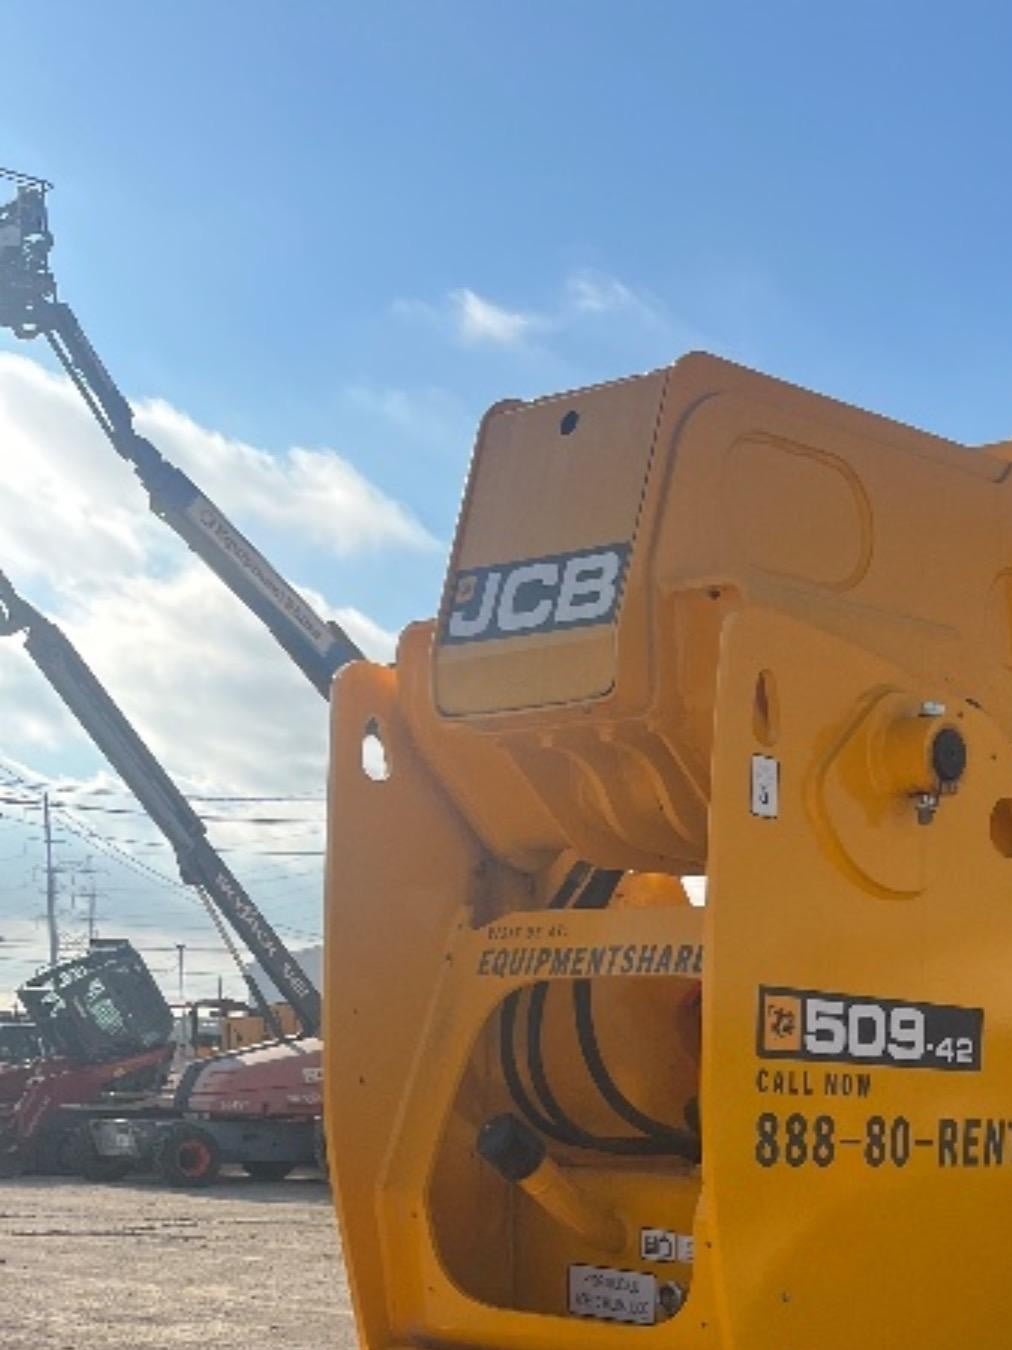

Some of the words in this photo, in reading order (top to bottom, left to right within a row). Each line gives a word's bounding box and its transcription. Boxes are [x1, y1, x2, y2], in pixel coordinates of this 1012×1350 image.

[449, 551, 619, 638] JCB
[756, 1069, 813, 1096] CALL
[824, 1074, 871, 1097] NOW
